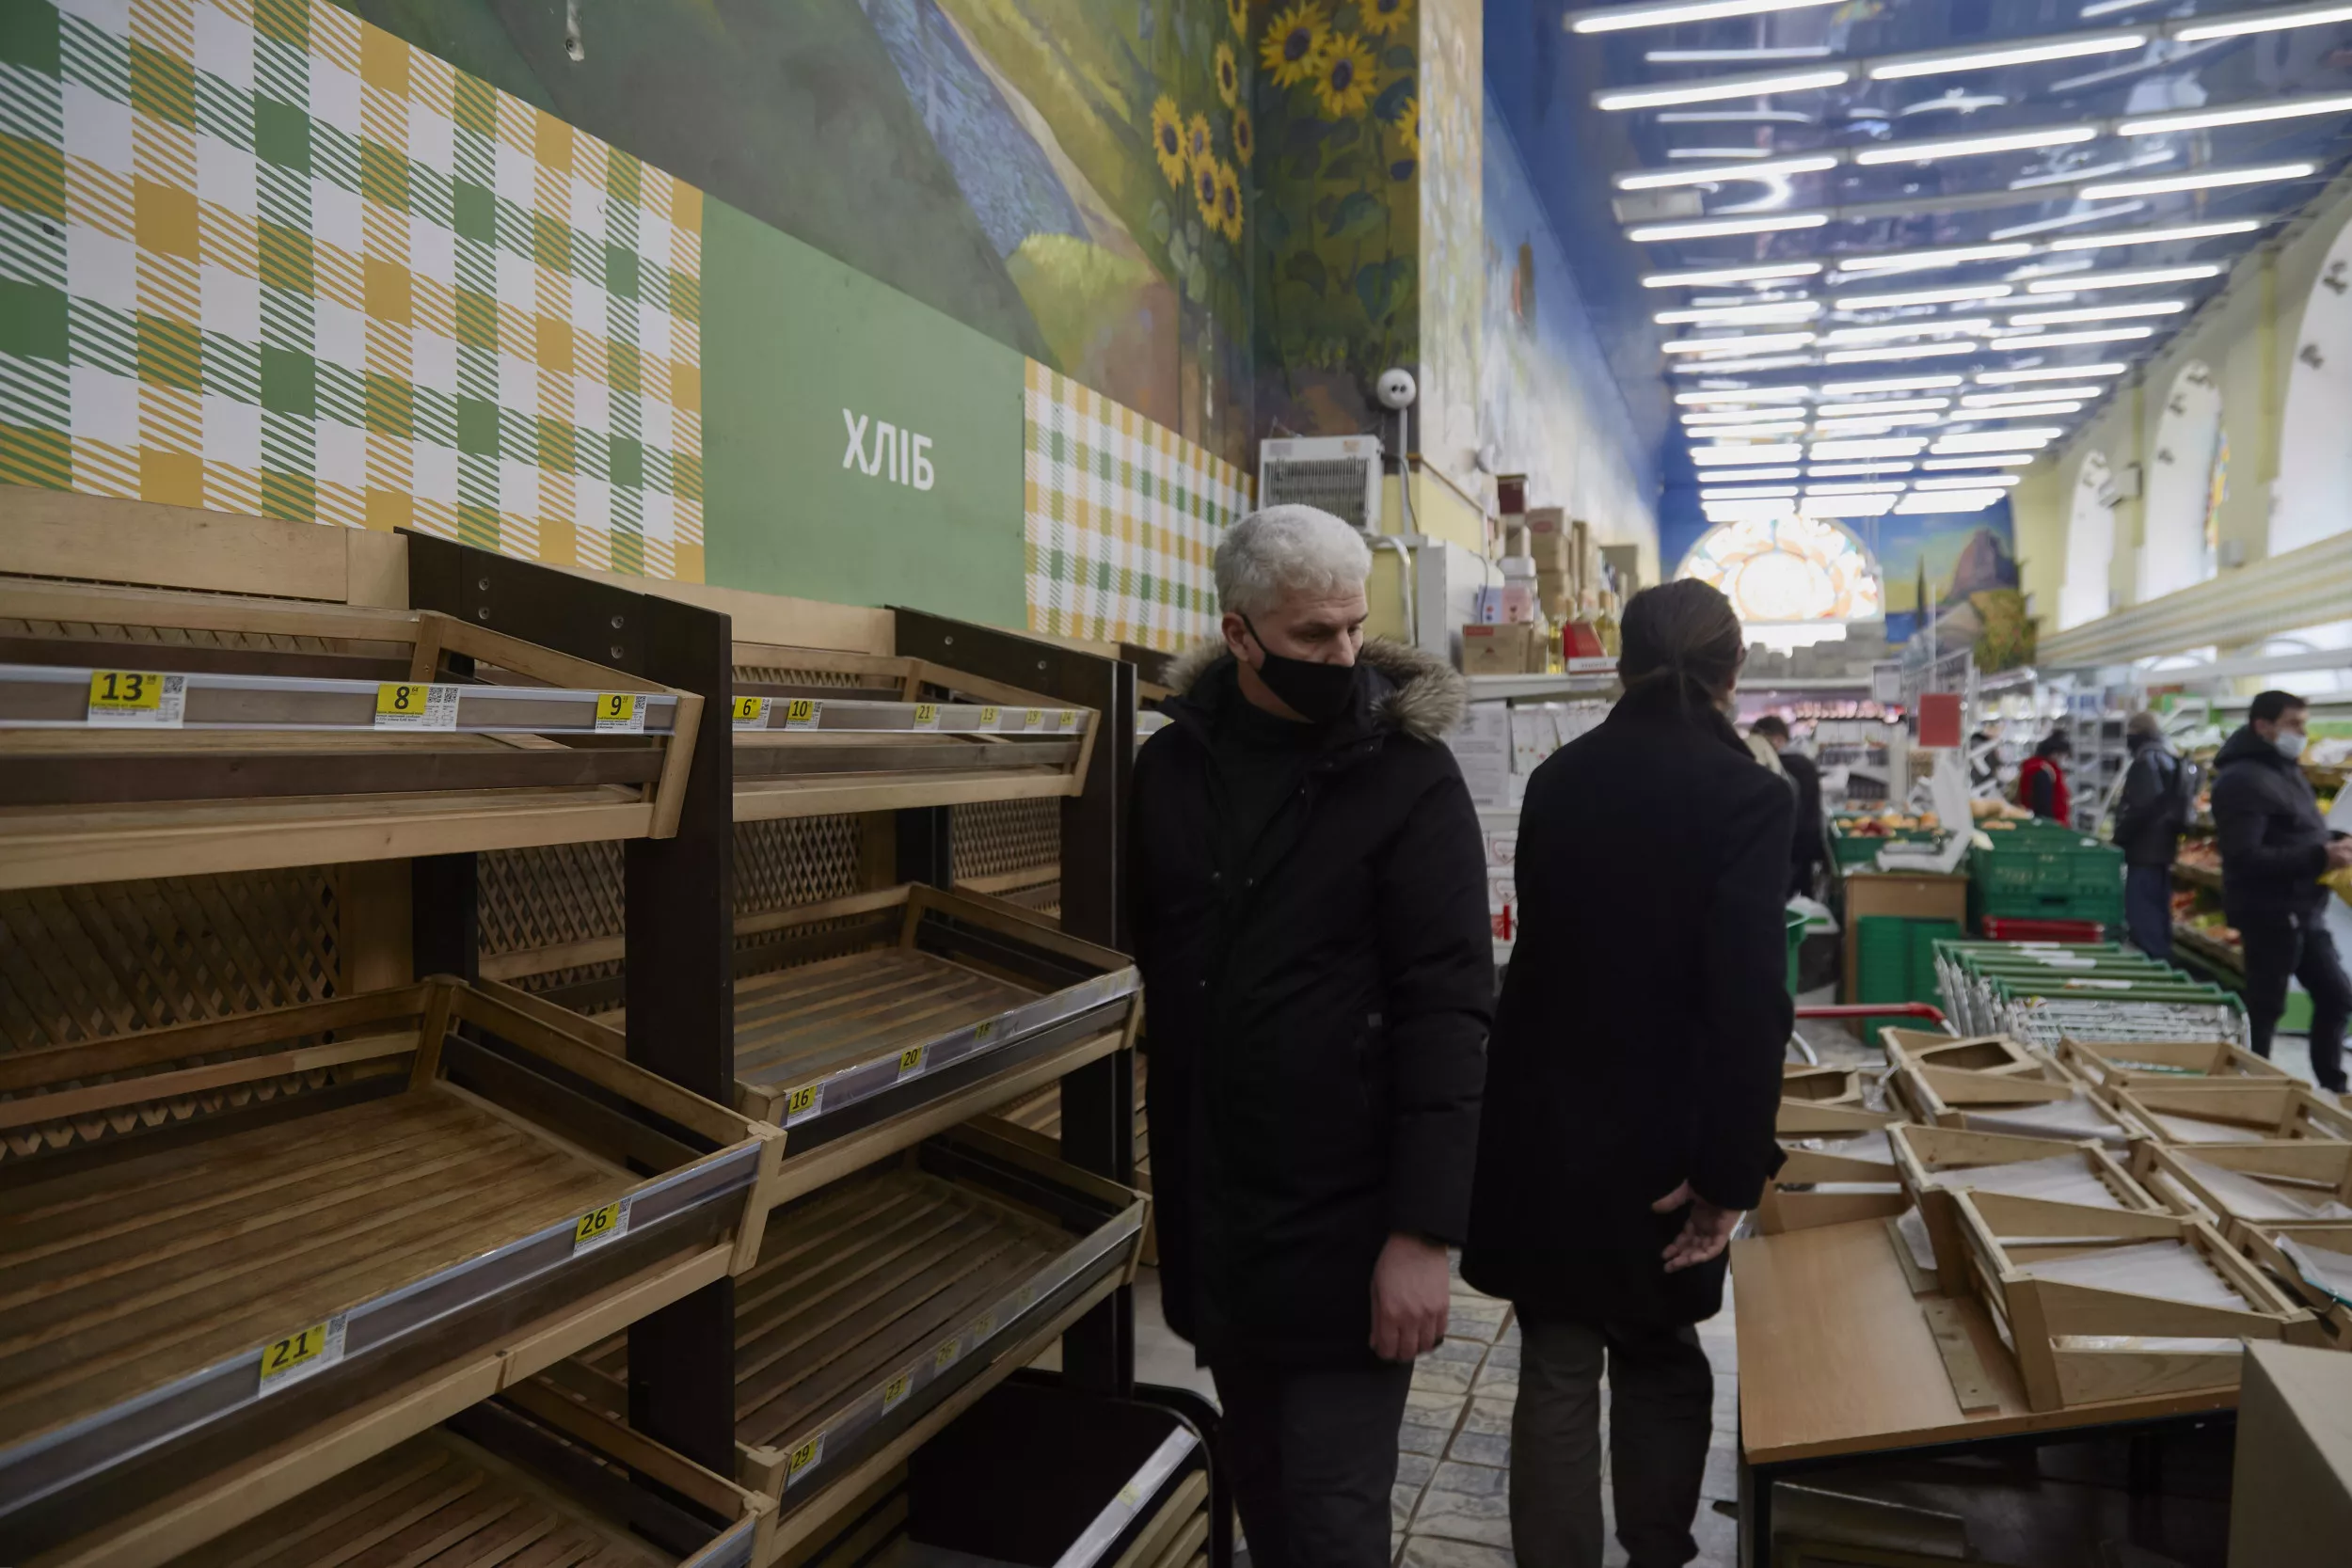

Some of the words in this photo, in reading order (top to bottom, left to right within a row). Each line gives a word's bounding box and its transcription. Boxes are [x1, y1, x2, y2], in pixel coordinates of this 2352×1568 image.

[842, 407, 934, 491] ХЛІБ
[101, 673, 144, 702] 13
[394, 686, 410, 710] 8
[610, 695, 622, 716] 9
[742, 698, 753, 716] 6
[791, 700, 809, 718] 10
[917, 705, 931, 720] 21
[903, 1048, 918, 1067] 20
[792, 1088, 810, 1110] 16
[580, 1207, 609, 1236] 26
[270, 1331, 310, 1370] 21
[793, 1444, 810, 1469] 29
